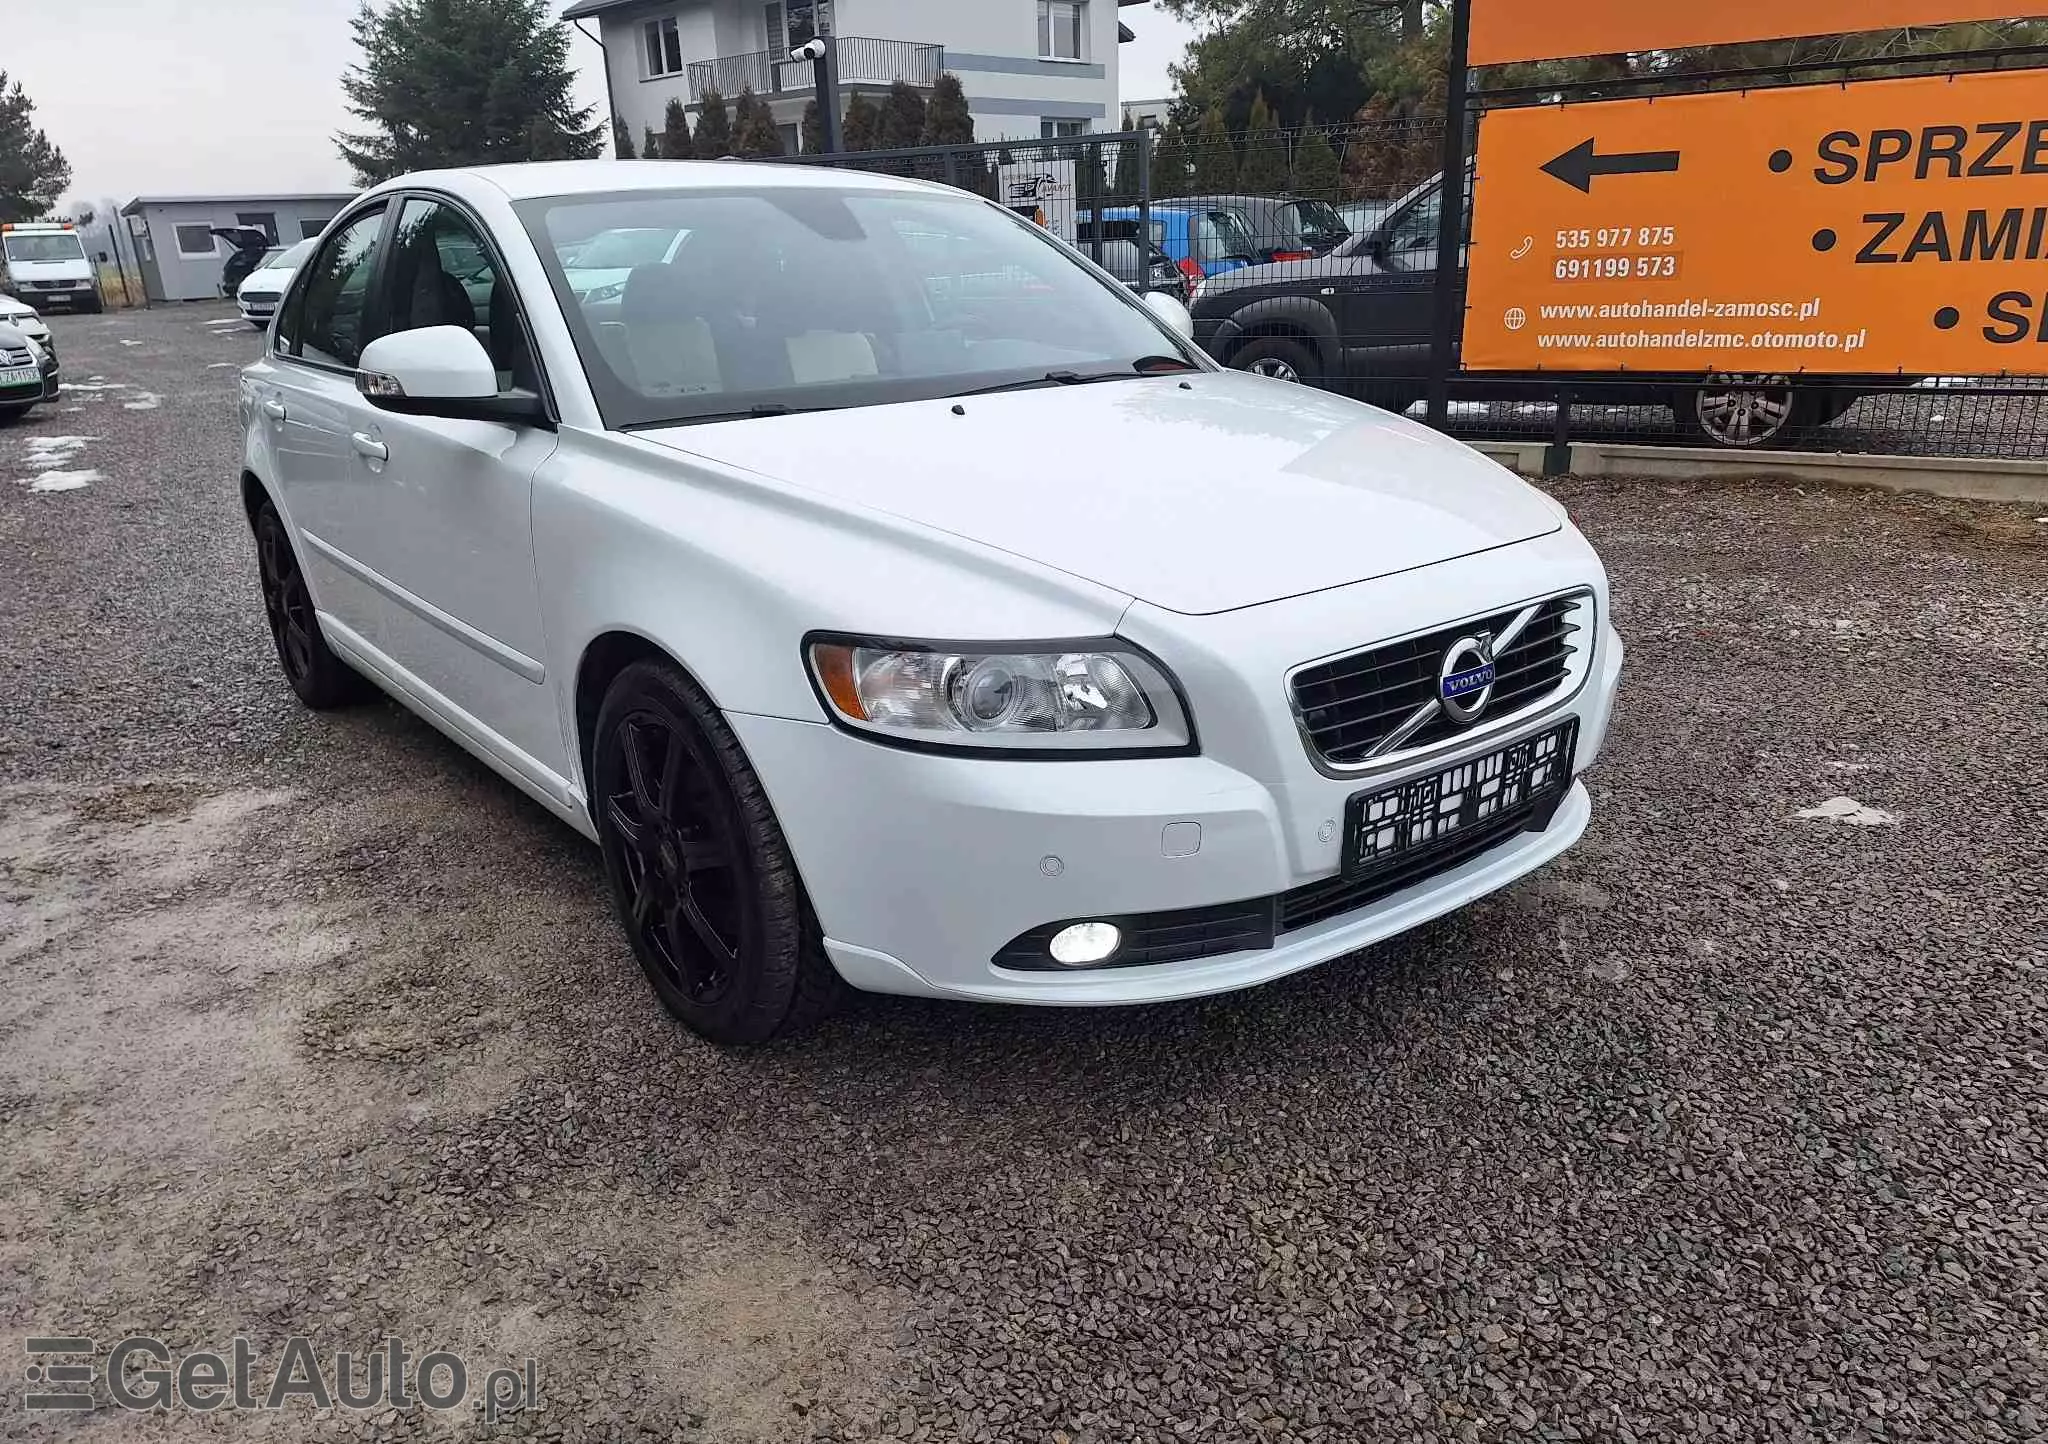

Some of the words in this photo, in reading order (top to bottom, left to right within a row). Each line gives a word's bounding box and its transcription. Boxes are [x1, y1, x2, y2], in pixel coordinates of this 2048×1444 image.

[1814, 119, 2048, 185] SPRZE
[1555, 230, 1590, 249] 535
[1597, 228, 1632, 248] 977
[1638, 226, 1675, 246] 875
[1855, 207, 2048, 263] ZAMI
[1636, 256, 1676, 277] 573
[1540, 298, 1821, 321] www.autohandel-zamosc.pl
[1537, 328, 1866, 352] www.autohandelzmc.otomoto.pl
[1446, 669, 1493, 691] VOLVO
